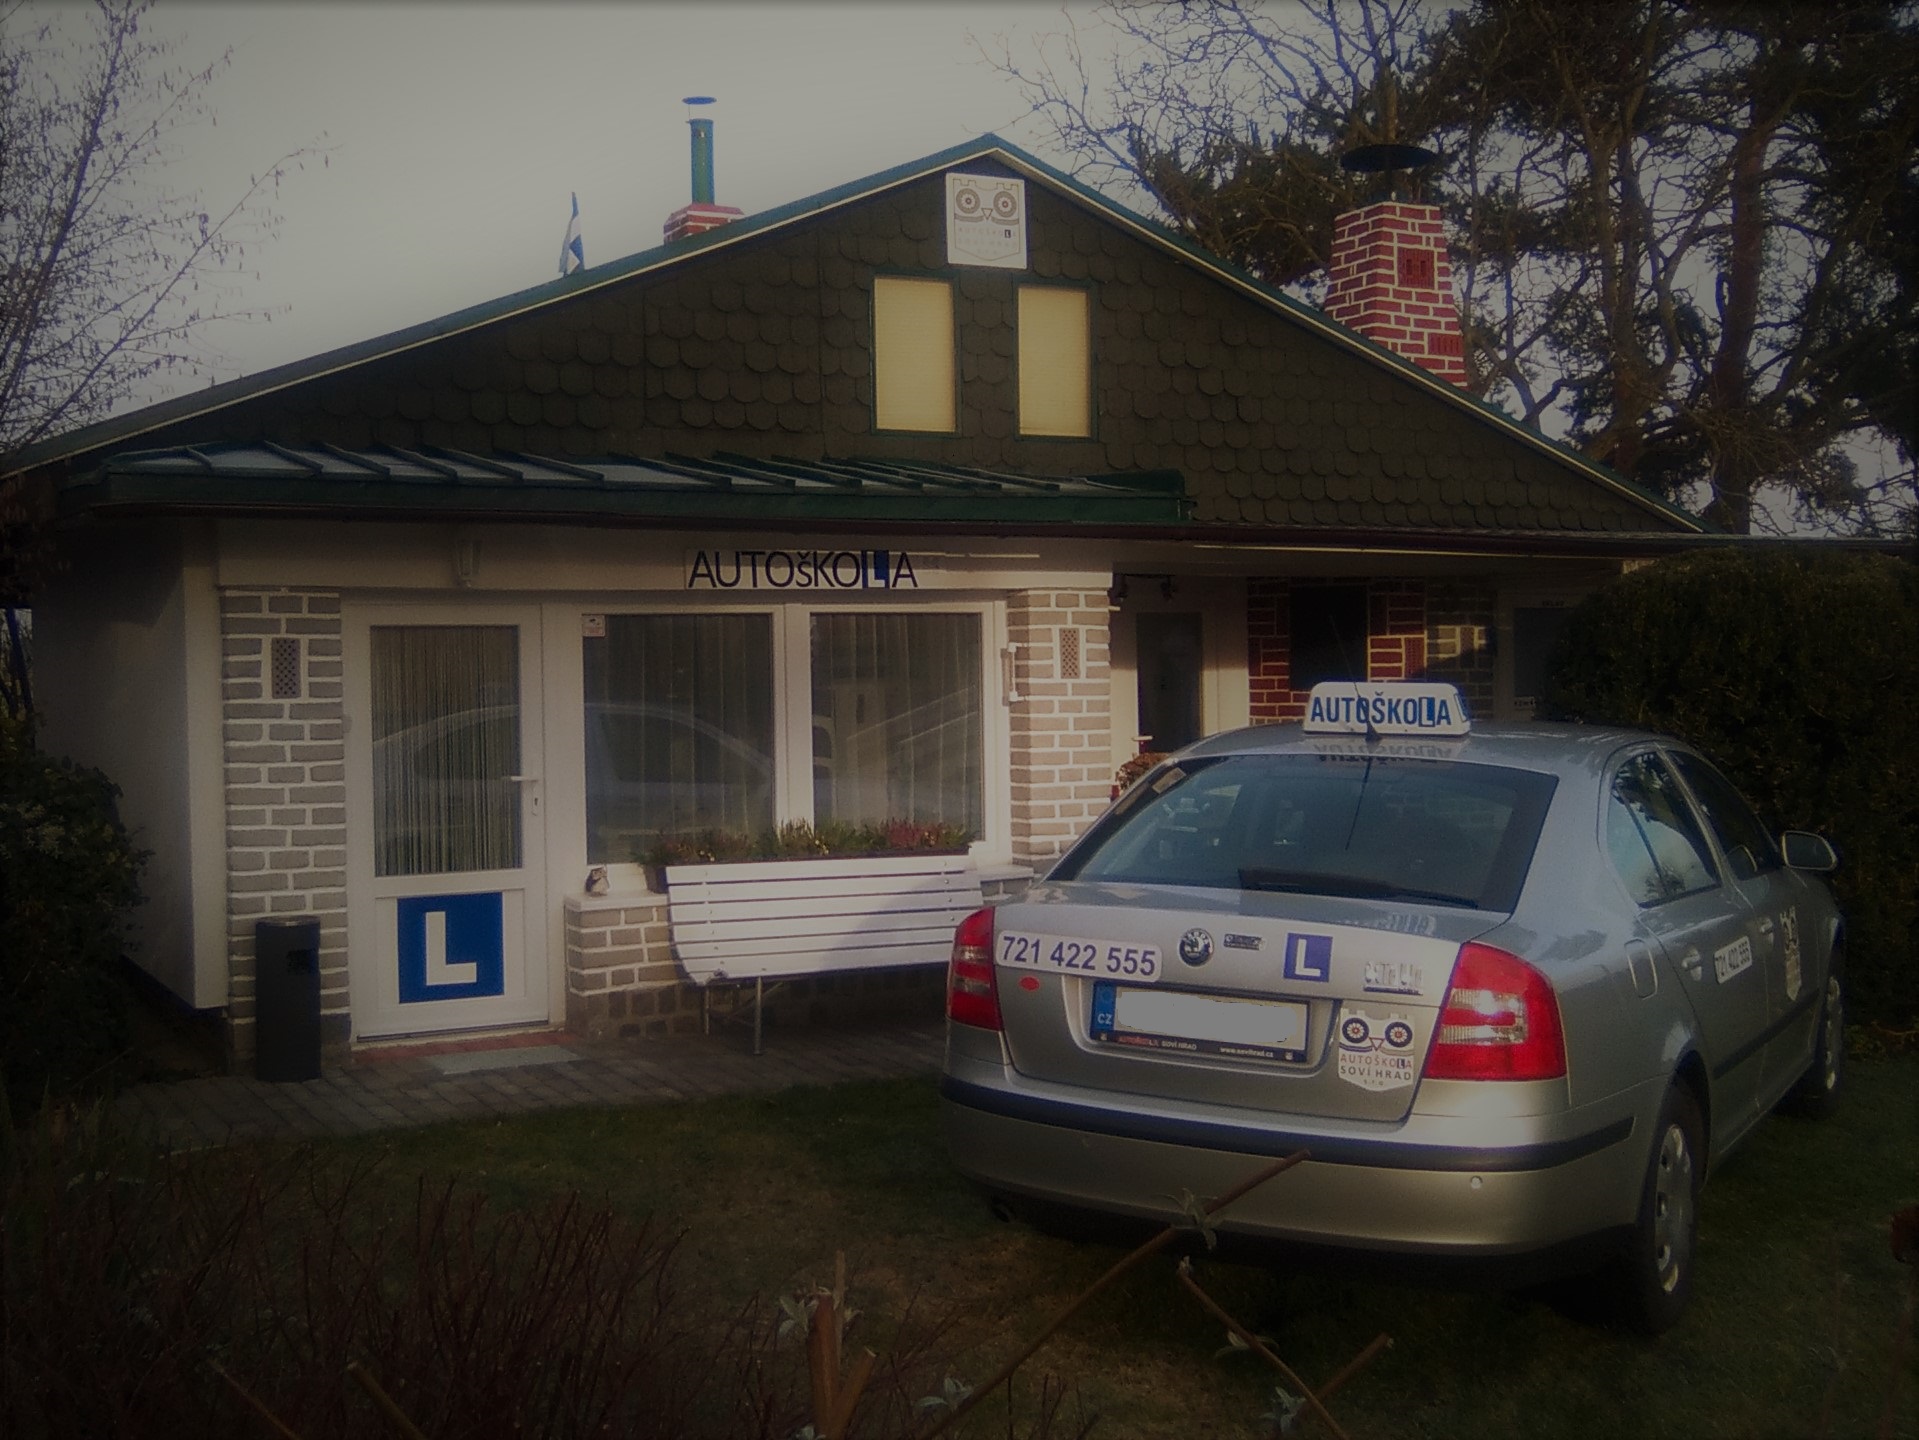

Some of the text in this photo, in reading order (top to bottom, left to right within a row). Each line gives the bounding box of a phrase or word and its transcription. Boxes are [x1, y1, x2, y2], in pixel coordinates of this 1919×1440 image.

[1310, 691, 1452, 727] AUTOŠKOLA
[425, 911, 477, 986] L
[1003, 935, 1155, 976] 721 422 555
[1295, 938, 1321, 977] L
[1097, 1013, 1112, 1025] CZ
[1340, 1054, 1412, 1069] AUTOŠKOLA
[1340, 1065, 1412, 1081] SOVÍ HRAD
